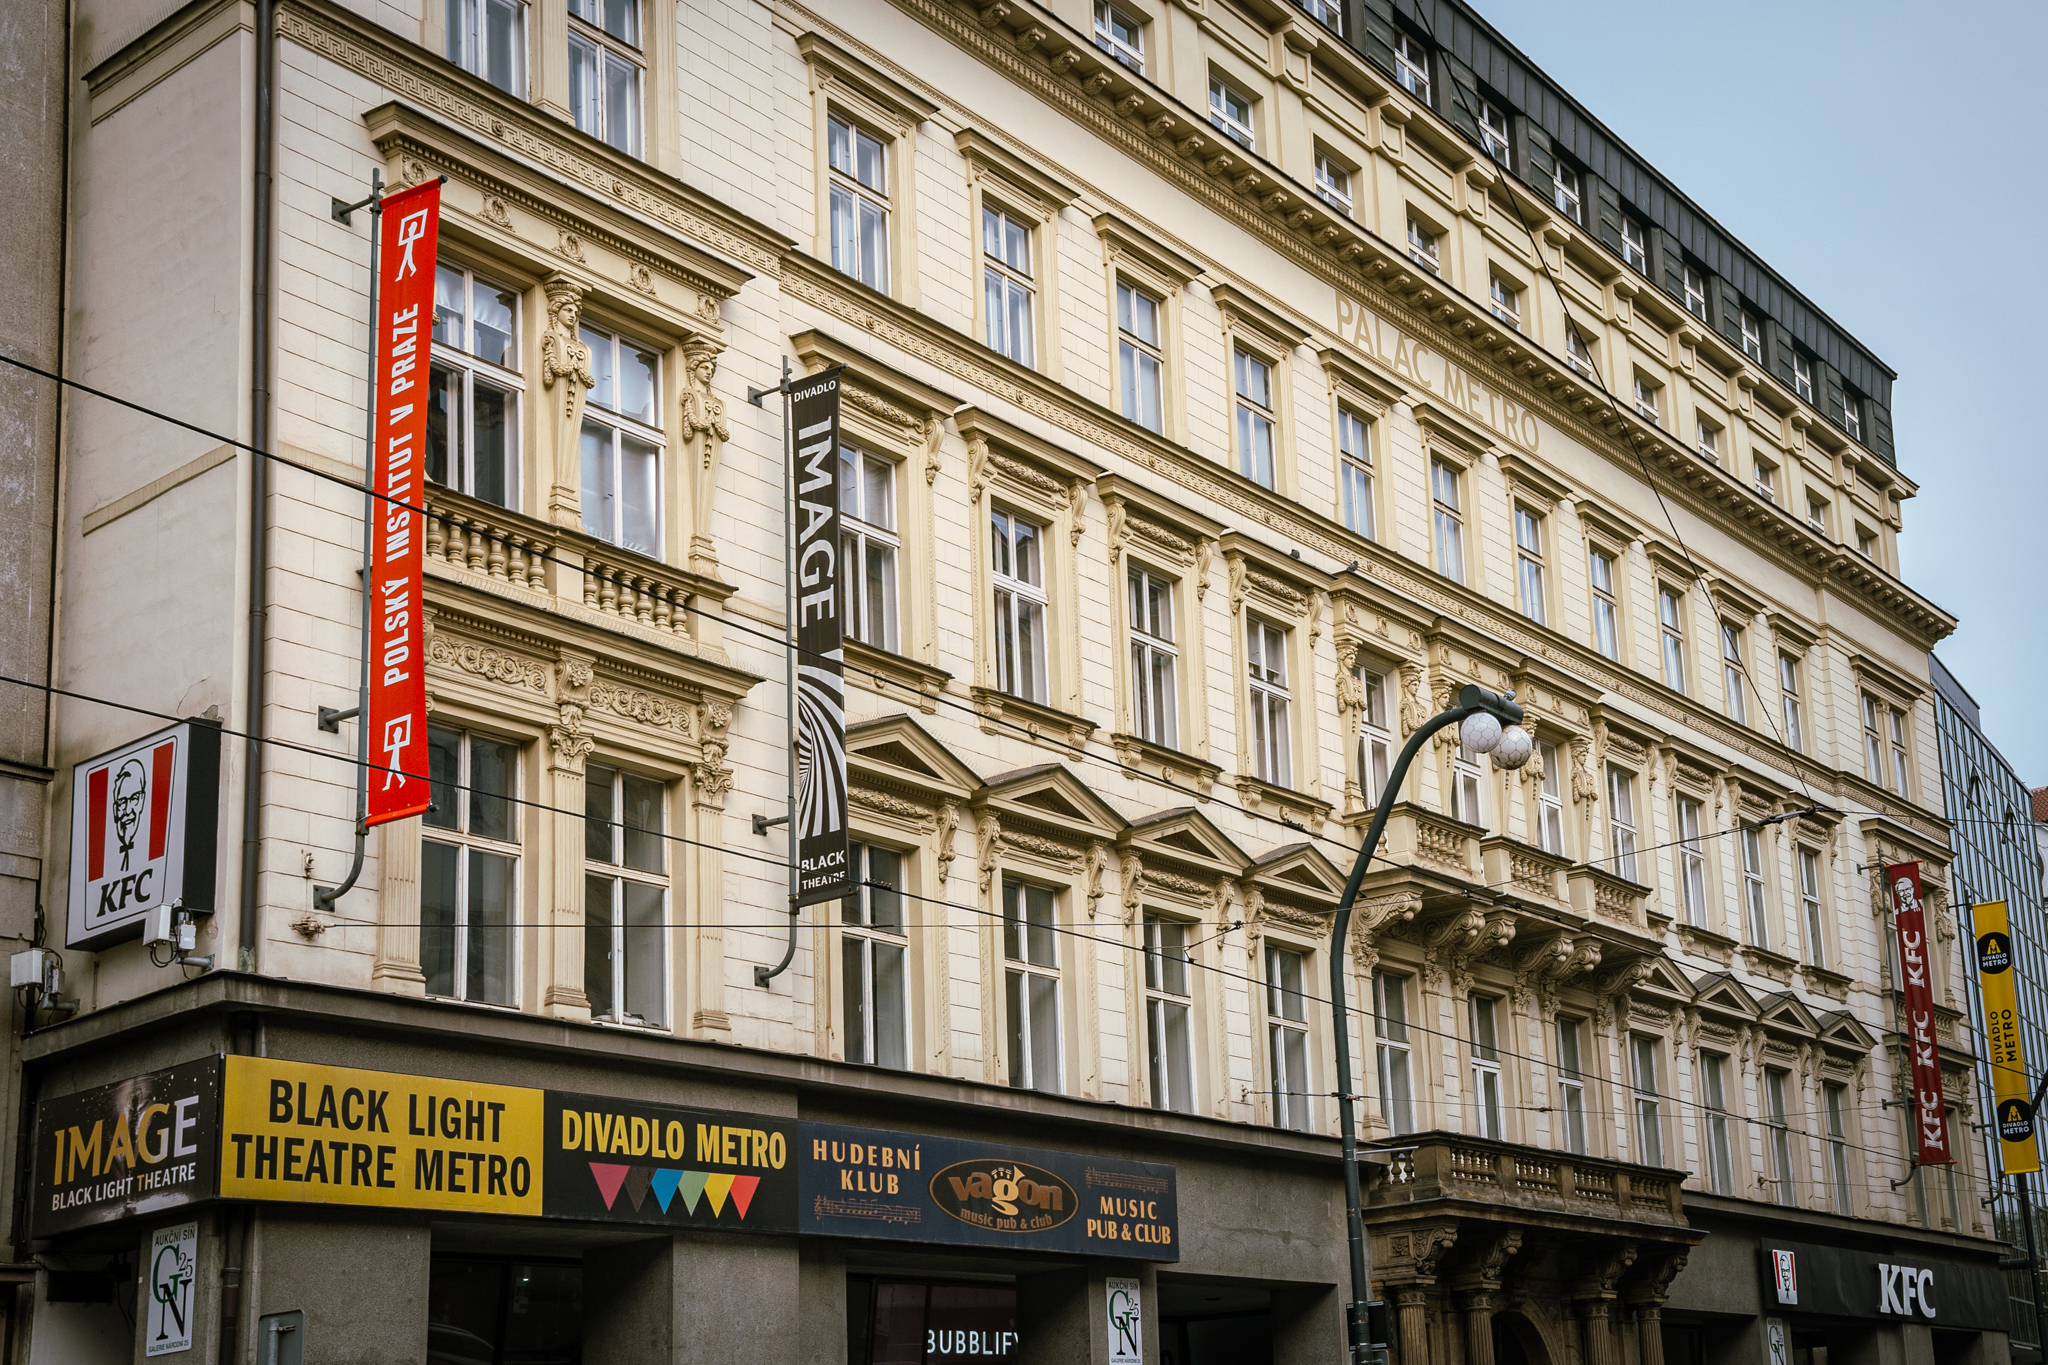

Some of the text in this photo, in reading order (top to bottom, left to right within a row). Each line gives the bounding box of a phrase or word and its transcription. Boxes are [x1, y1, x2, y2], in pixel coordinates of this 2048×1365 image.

[794, 380, 836, 403] DIVADLO
[1444, 359, 1539, 453] METRO
[381, 303, 418, 687] POLSKÝ INSTITUT V PRAZE
[799, 415, 835, 628] IMAGE
[801, 850, 845, 873] BLACK
[801, 871, 845, 890] THEATRE
[97, 868, 153, 918] KFC
[1904, 929, 1925, 988] KFC
[1982, 952, 2008, 961] DIVADLO
[1983, 959, 2008, 967] METRO
[1914, 1009, 1934, 1069] KFC
[1989, 1010, 2004, 1063] DIVADLO
[2001, 1009, 2017, 1062] METRO
[269, 1079, 506, 1143] BLACK LIGHT
[1922, 1090, 1943, 1151] KFC
[2002, 1120, 2029, 1129] DIVADLO
[2003, 1125, 2030, 1134] METRO
[53, 1095, 200, 1186] IMAGE
[562, 1109, 787, 1170] DIVADLO METRO
[813, 1139, 920, 1171] HUDEBNÍ
[51, 1162, 196, 1212] BLACK LIGHT THEATRE
[231, 1133, 532, 1198] THEATRE METRO
[841, 1169, 899, 1194] KLUB
[948, 1165, 1063, 1216] vagon
[960, 1208, 1053, 1231] music pub & club
[1087, 1218, 1171, 1244] PUB & CLUB
[1100, 1197, 1157, 1220] MUSIC
[155, 1228, 181, 1246] AUKČNÍ
[178, 1252, 193, 1277] 25
[1129, 1298, 1139, 1316] 25
[1878, 1263, 1936, 1318] KFC
